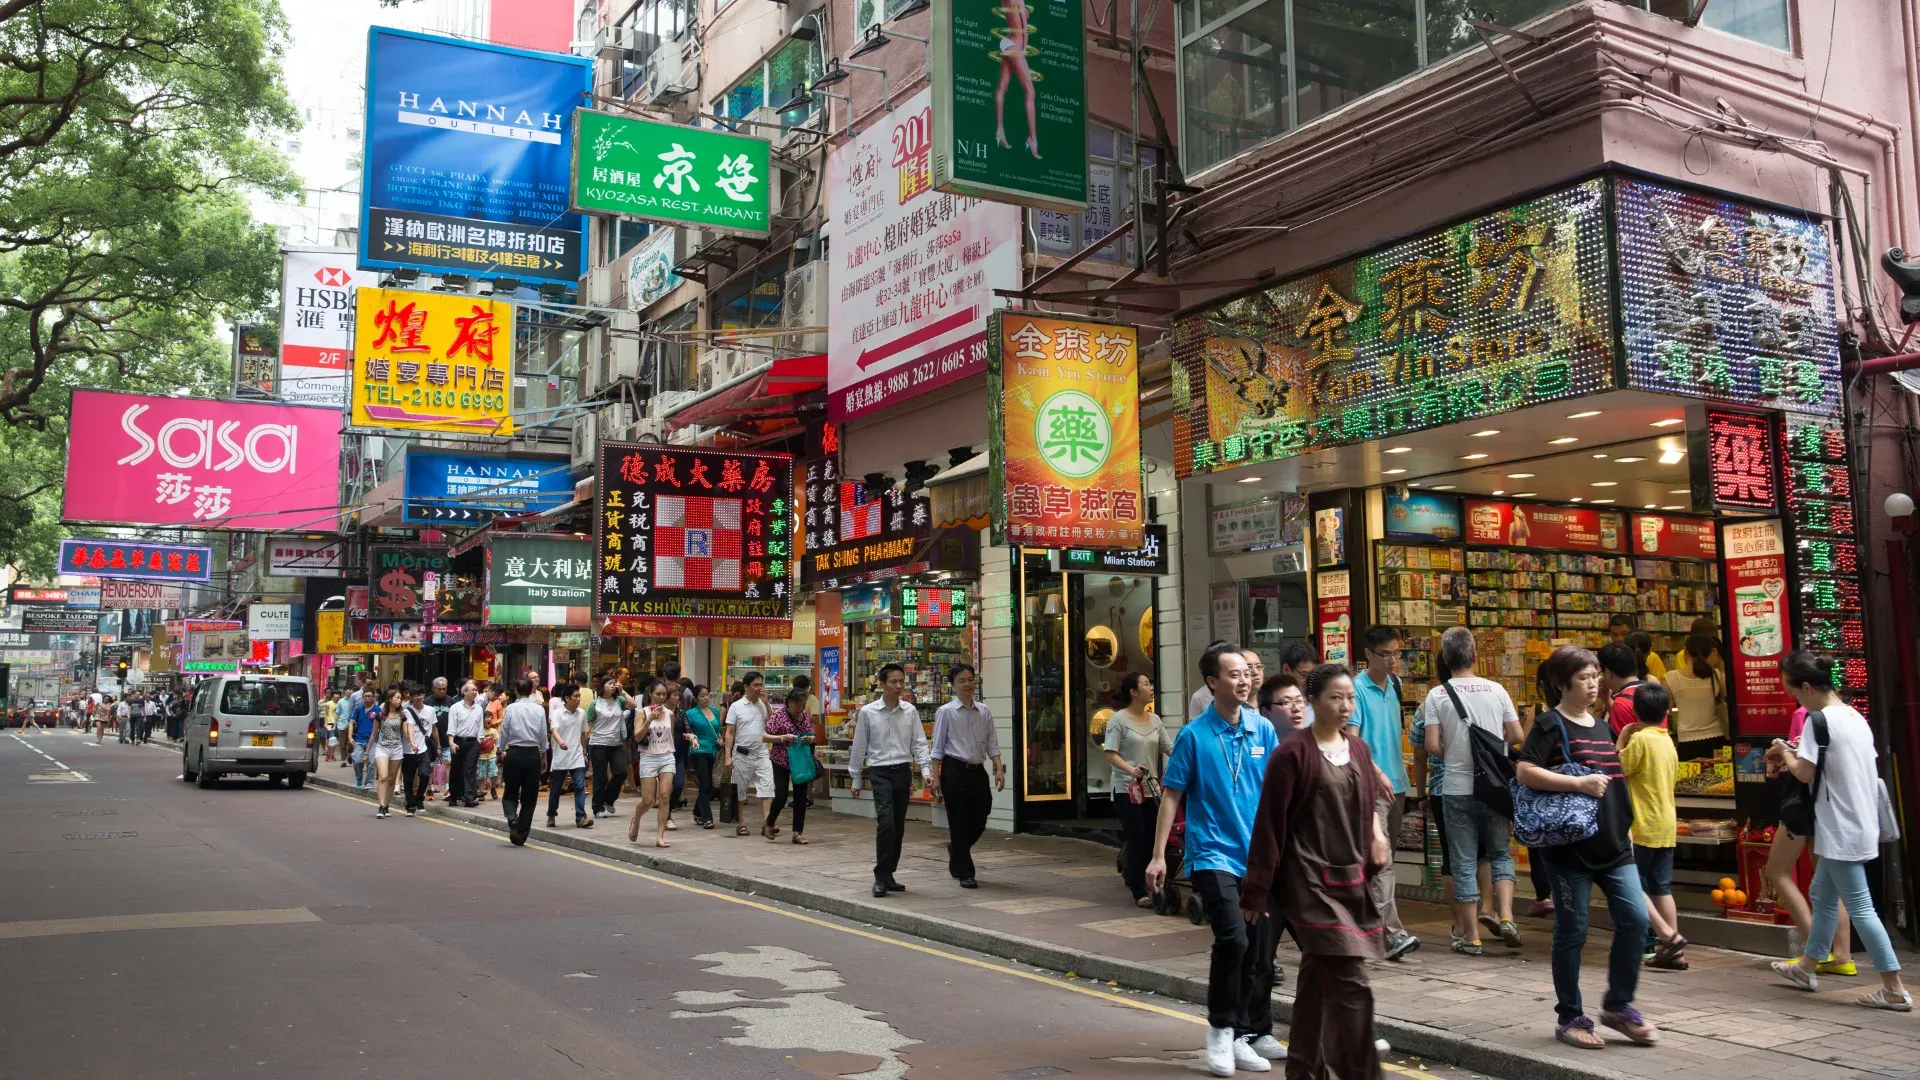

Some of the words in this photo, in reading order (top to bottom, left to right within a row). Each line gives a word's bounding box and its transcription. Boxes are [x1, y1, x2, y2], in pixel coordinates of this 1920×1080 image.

[955, 28, 967, 37] Hair
[967, 31, 992, 42] Removal
[1048, 39, 1073, 52] Slimming
[956, 74, 979, 85] Serenity
[979, 78, 992, 87] Skin
[956, 85, 992, 99] Rejuvenation
[1070, 97, 1080, 106] Plus
[398, 91, 562, 130] HANNAH
[1049, 104, 1075, 116] Diagnosis
[428, 117, 533, 139] OUTLET
[958, 158, 988, 169] Worldwide
[390, 164, 425, 175] GUCCI
[450, 171, 487, 183] PRADA
[538, 182, 566, 193] DIOR
[592, 167, 641, 188] 居酒屋
[387, 183, 439, 197] BOTTEGA
[442, 188, 484, 203] VENETA
[532, 201, 564, 213] FENDI
[438, 199, 463, 210] D&G
[518, 189, 539, 200] MIU
[541, 193, 563, 203] MIU
[586, 187, 658, 207] KYOZASA
[661, 197, 700, 212] REST
[703, 205, 763, 221] AURANT
[844, 190, 884, 226] 婚宴專門店
[384, 216, 565, 255] 漢納歐洲名牌折扣店
[408, 241, 540, 269] 海利行3樓及4樓全層
[1296, 223, 1551, 370] 金燕坊
[373, 300, 500, 363] 煌府
[1010, 321, 1133, 368] 金燕坊
[1446, 326, 1546, 371] Store
[319, 352, 341, 366] 2/F
[912, 361, 935, 387] 2622
[941, 349, 966, 374] 6605
[365, 357, 506, 391] 婚宴專門店
[1016, 362, 1051, 378] Kam
[1056, 365, 1082, 381] Yin
[1086, 368, 1128, 384] Store
[364, 384, 456, 408] TEL-2180
[461, 393, 505, 412] 6990
[1044, 404, 1105, 463] 藥
[1712, 419, 1769, 500] 藥
[448, 464, 539, 480] HANNAH
[620, 452, 776, 493] 德成大藥房
[156, 473, 231, 519] 莎莎
[1011, 483, 1072, 519] 蟲草
[1080, 488, 1138, 522] 燕窩
[1231, 508, 1255, 519] Eyelash
[1256, 502, 1279, 513] Beauty
[604, 490, 625, 573] 正貨商號
[746, 499, 765, 577] 政府註冊
[767, 499, 788, 578] 專業配藥
[1732, 524, 1775, 540] 政府註冊
[815, 555, 830, 571] TAK
[833, 548, 860, 569] SHING
[864, 537, 915, 562] PHARMACY
[1070, 551, 1092, 561] EXIT
[1733, 539, 1776, 554] 信心保證
[382, 553, 455, 572] Money
[504, 556, 592, 580] 意大利站
[1104, 556, 1126, 566] Milan
[1127, 557, 1156, 568] Station
[101, 583, 163, 599] HENDERSON
[528, 587, 549, 599] Italy
[552, 589, 585, 598] Station
[603, 576, 649, 596] 燕窩
[131, 600, 156, 608] FURNITURE
[164, 600, 180, 608] CHEST
[609, 601, 640, 613] TAK
[643, 602, 693, 615] SHING
[697, 603, 781, 617] PHARMACY
[260, 611, 289, 619] CULTE
[371, 623, 392, 643] 4D
[818, 626, 841, 637] mannings
